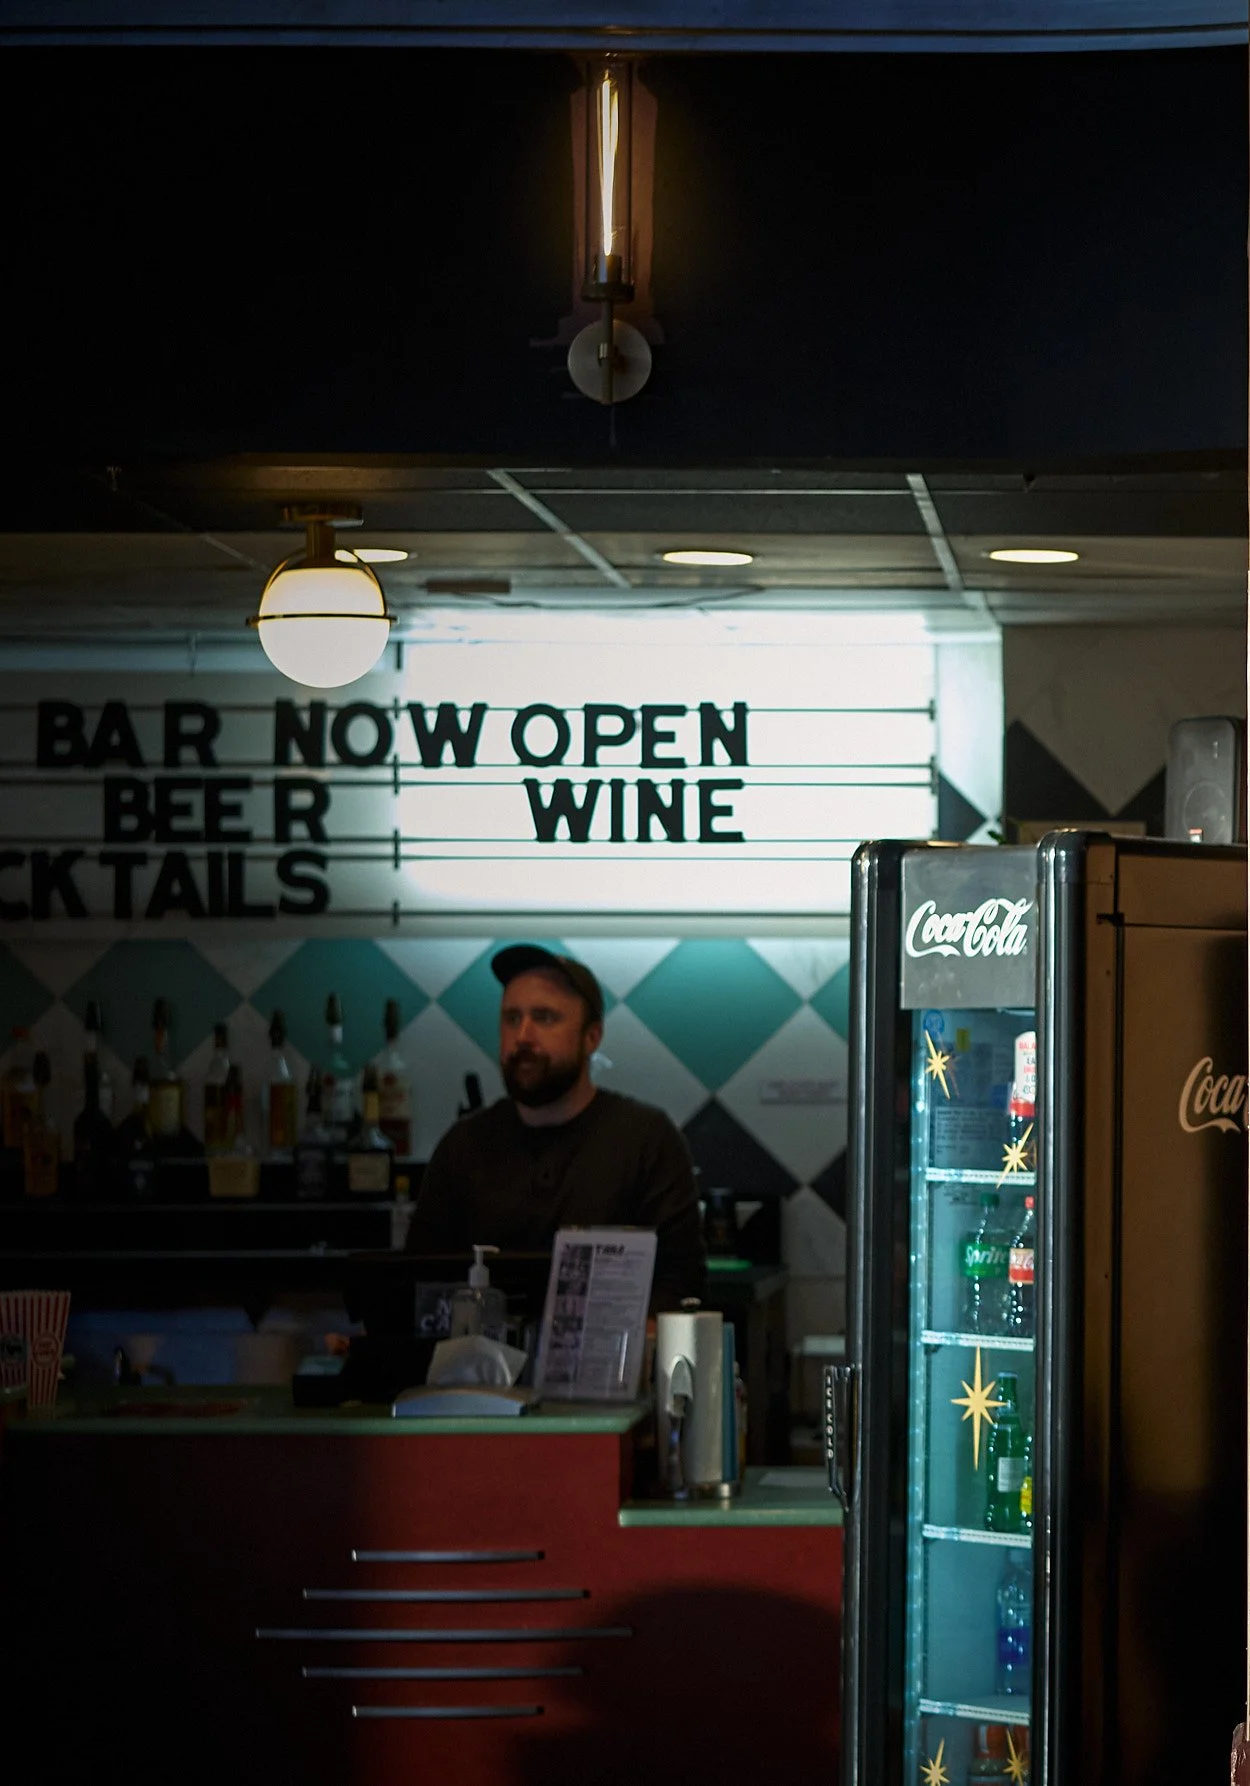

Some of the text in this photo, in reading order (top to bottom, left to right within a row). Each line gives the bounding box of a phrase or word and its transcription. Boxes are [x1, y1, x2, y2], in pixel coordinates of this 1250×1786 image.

[37, 697, 748, 768] BAR NOW OPEN
[104, 777, 745, 843] BEER WINE
